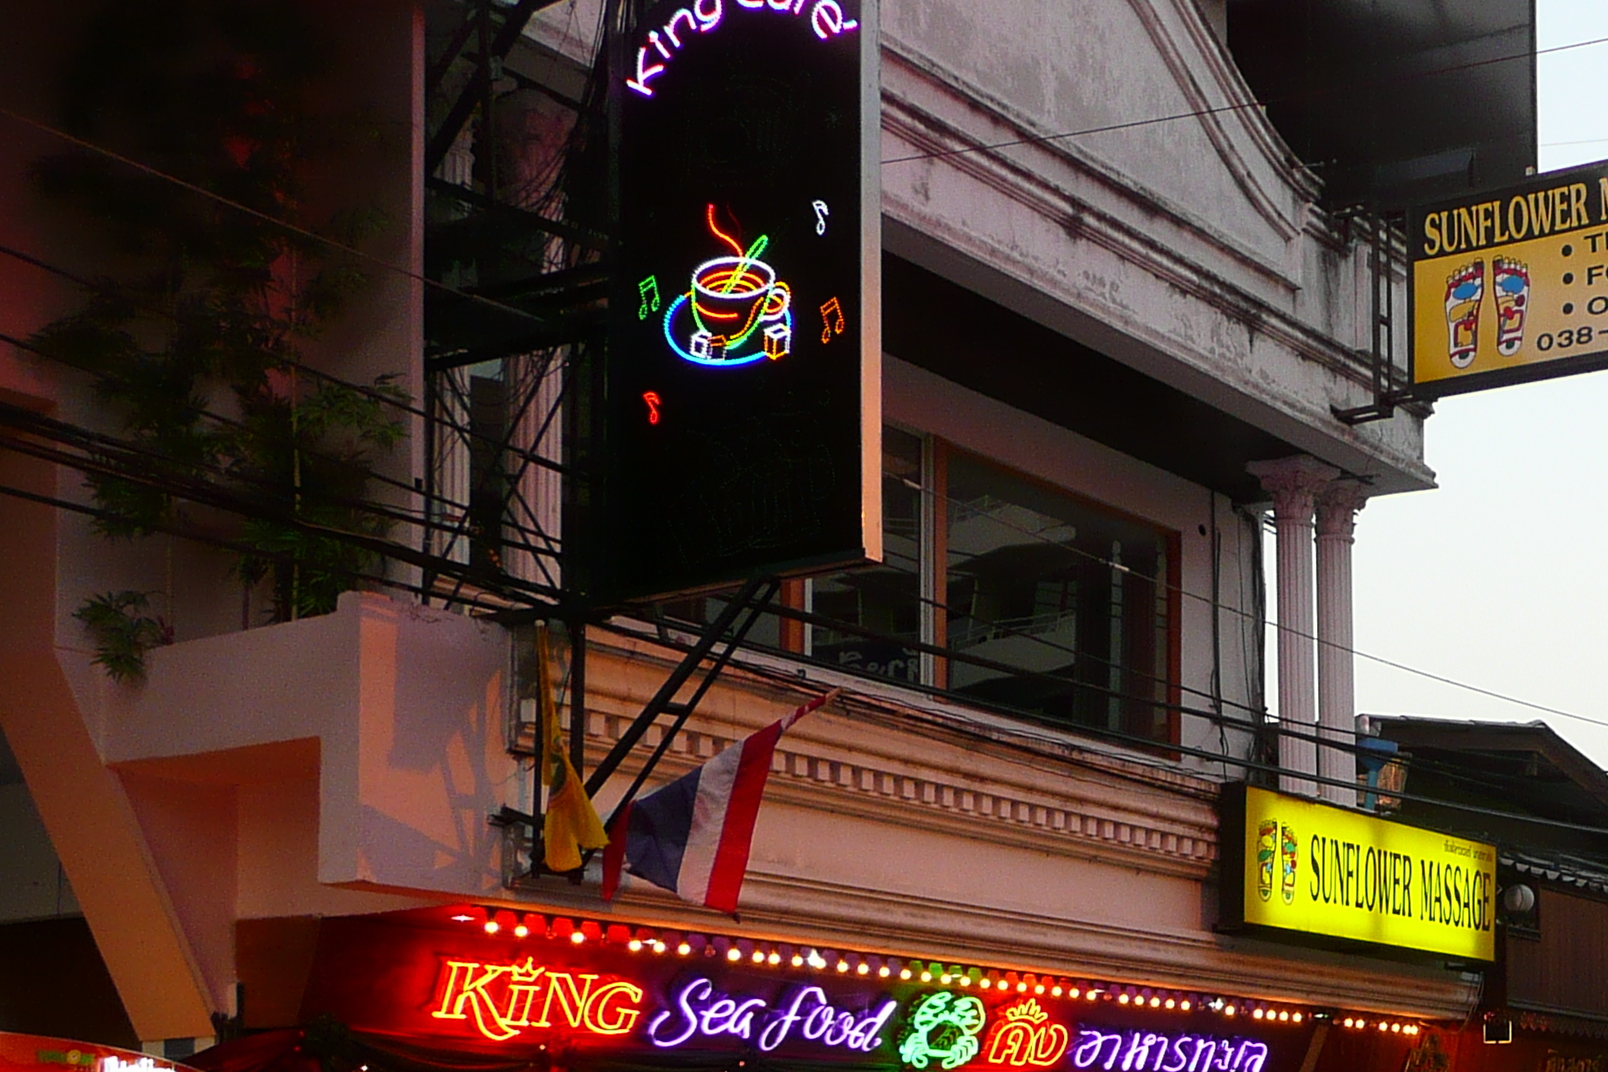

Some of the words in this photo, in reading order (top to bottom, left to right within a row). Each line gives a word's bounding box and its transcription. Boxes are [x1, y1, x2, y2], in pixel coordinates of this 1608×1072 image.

[626, 0, 723, 97] King
[1423, 182, 1590, 256] SUNFLOWER
[1309, 834, 1413, 918] SUNFLOWER
[1419, 858, 1492, 932] MASSAGE
[433, 960, 644, 1040] KING
[648, 978, 767, 1048] Sea
